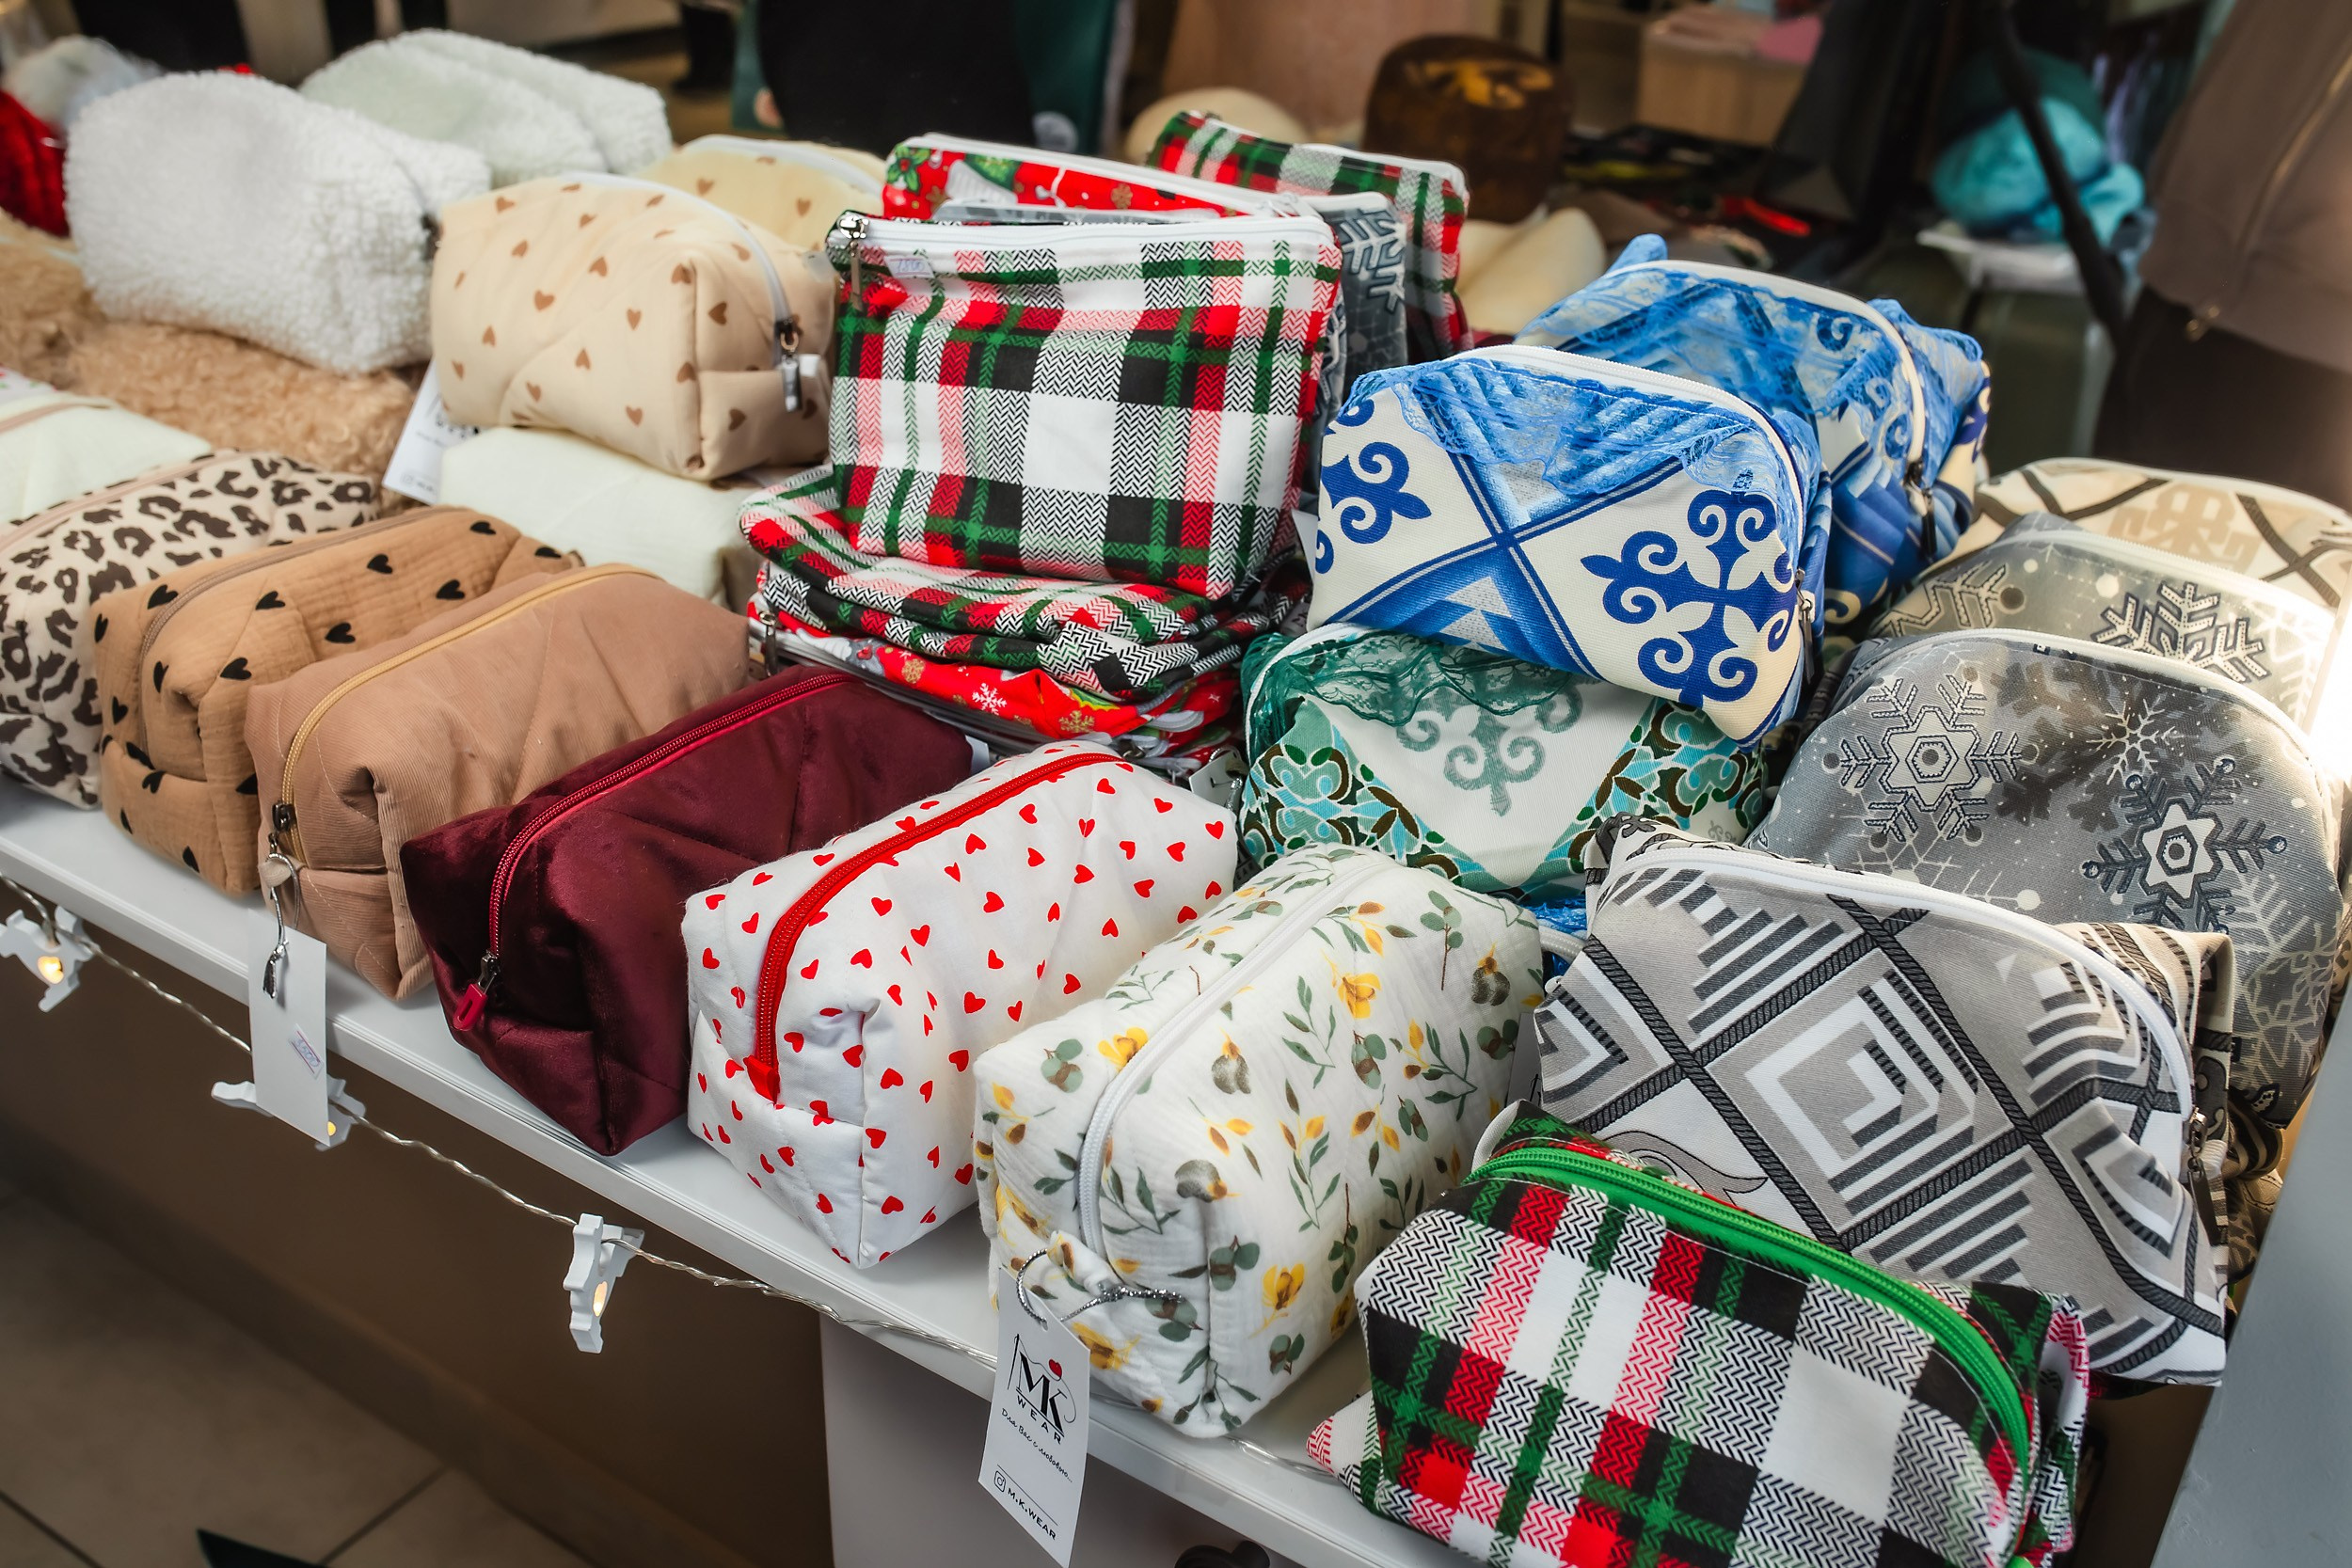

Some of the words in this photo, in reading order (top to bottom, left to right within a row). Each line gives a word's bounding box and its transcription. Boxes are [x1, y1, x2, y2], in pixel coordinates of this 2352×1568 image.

[1016, 1351, 1067, 1435] MK
[1001, 1407, 1017, 1428] Для
[1018, 1425, 1033, 1442] Вас
[1017, 1395, 1062, 1445] WEAR
[1008, 1487, 1057, 1541] M.K.WEAR
